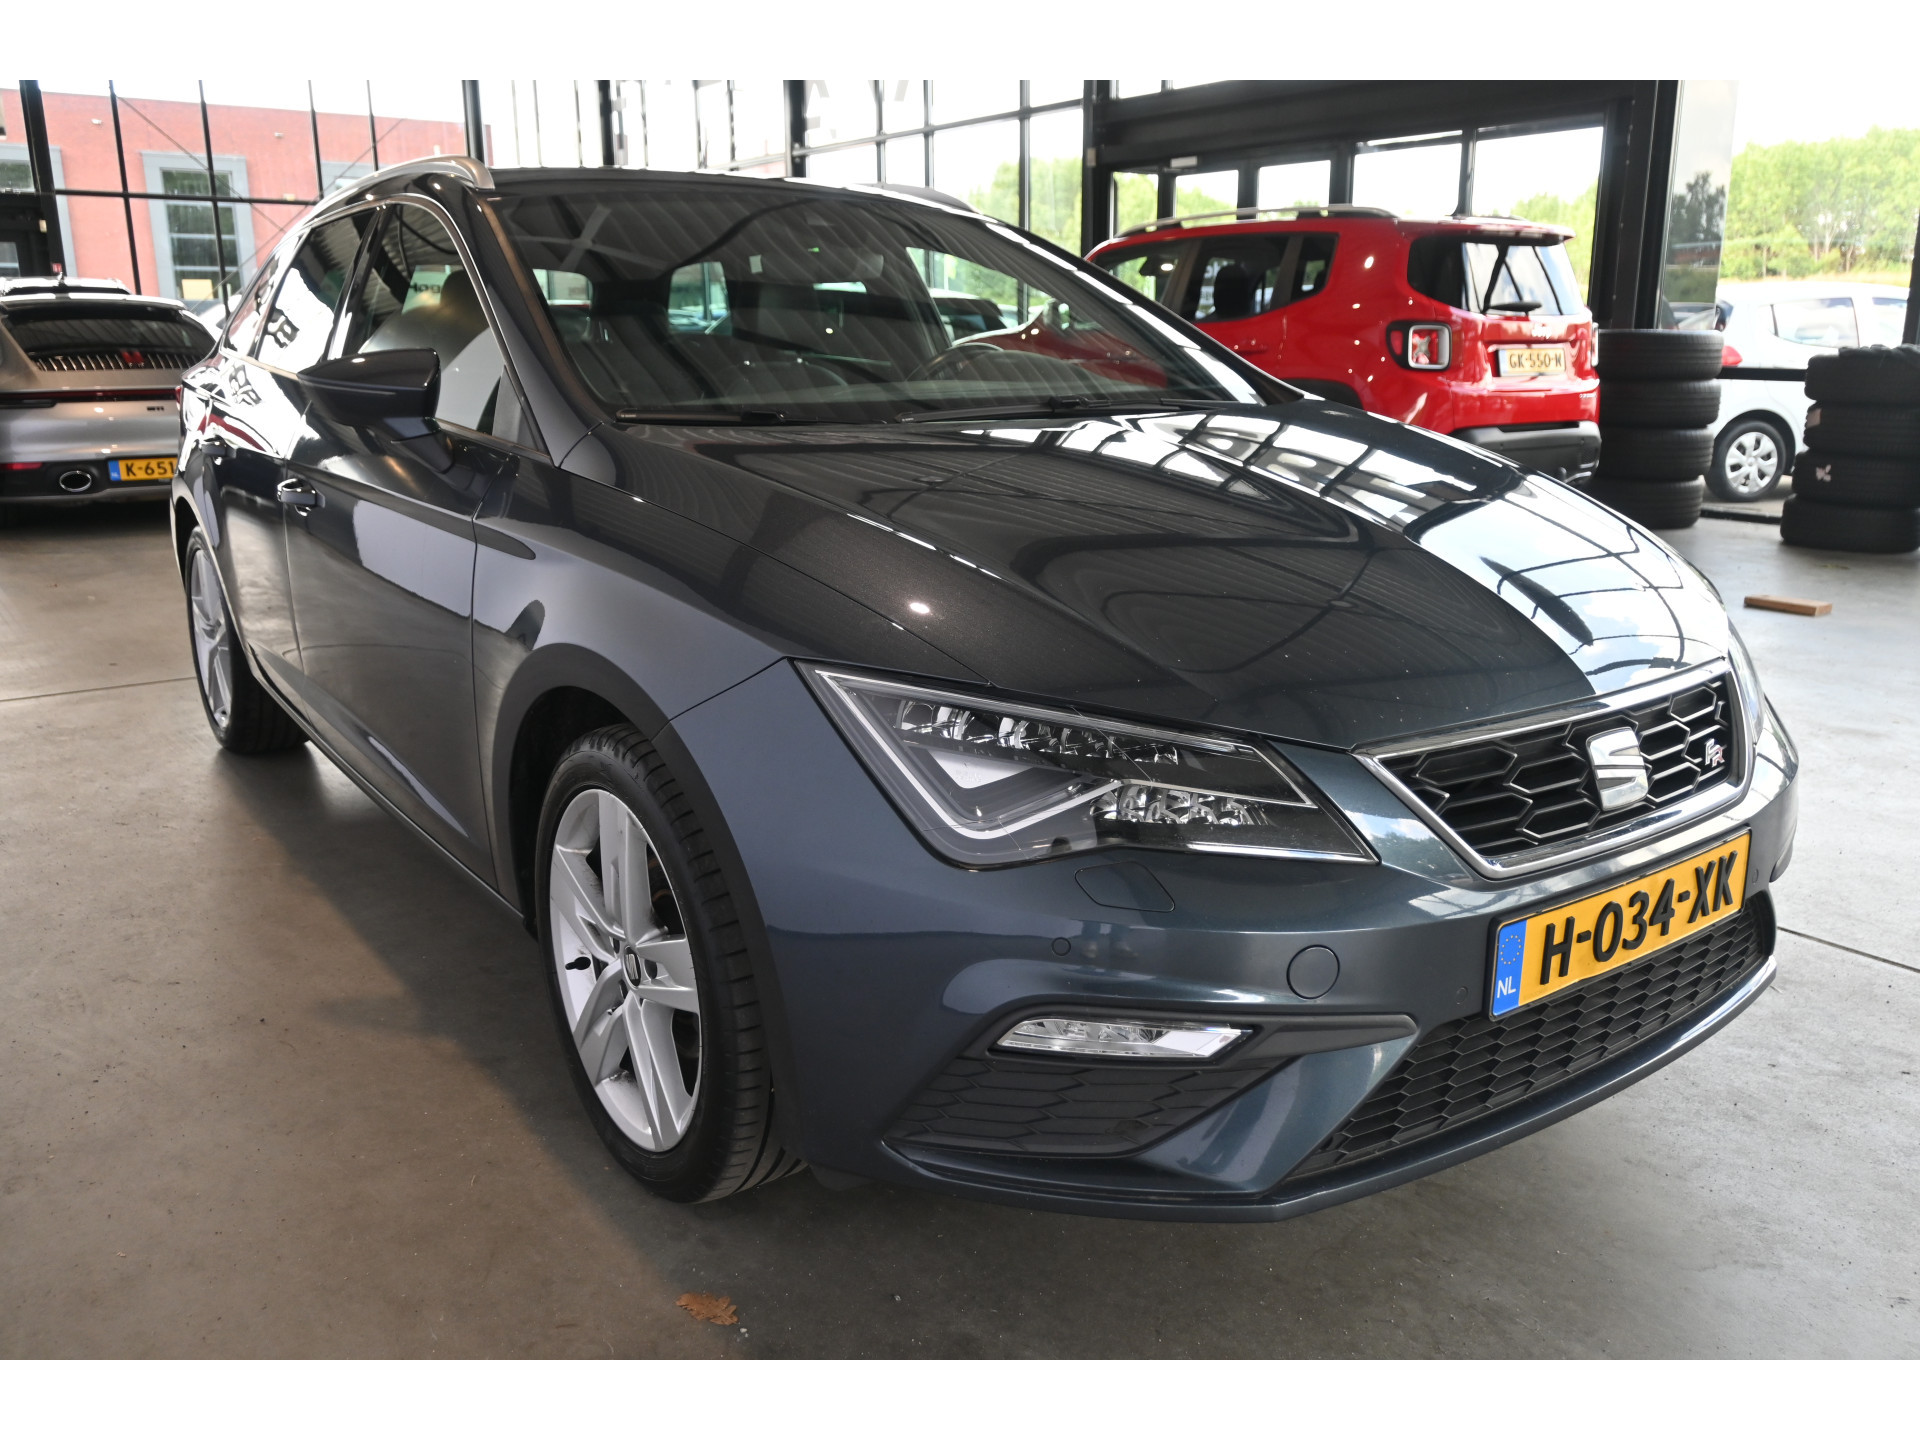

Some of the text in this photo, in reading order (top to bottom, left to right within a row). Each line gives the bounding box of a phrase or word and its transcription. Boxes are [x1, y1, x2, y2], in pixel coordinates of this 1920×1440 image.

[1704, 738, 1725, 767] FR
[1539, 850, 1738, 985] H-034-XK
[1497, 976, 1516, 999] NL
